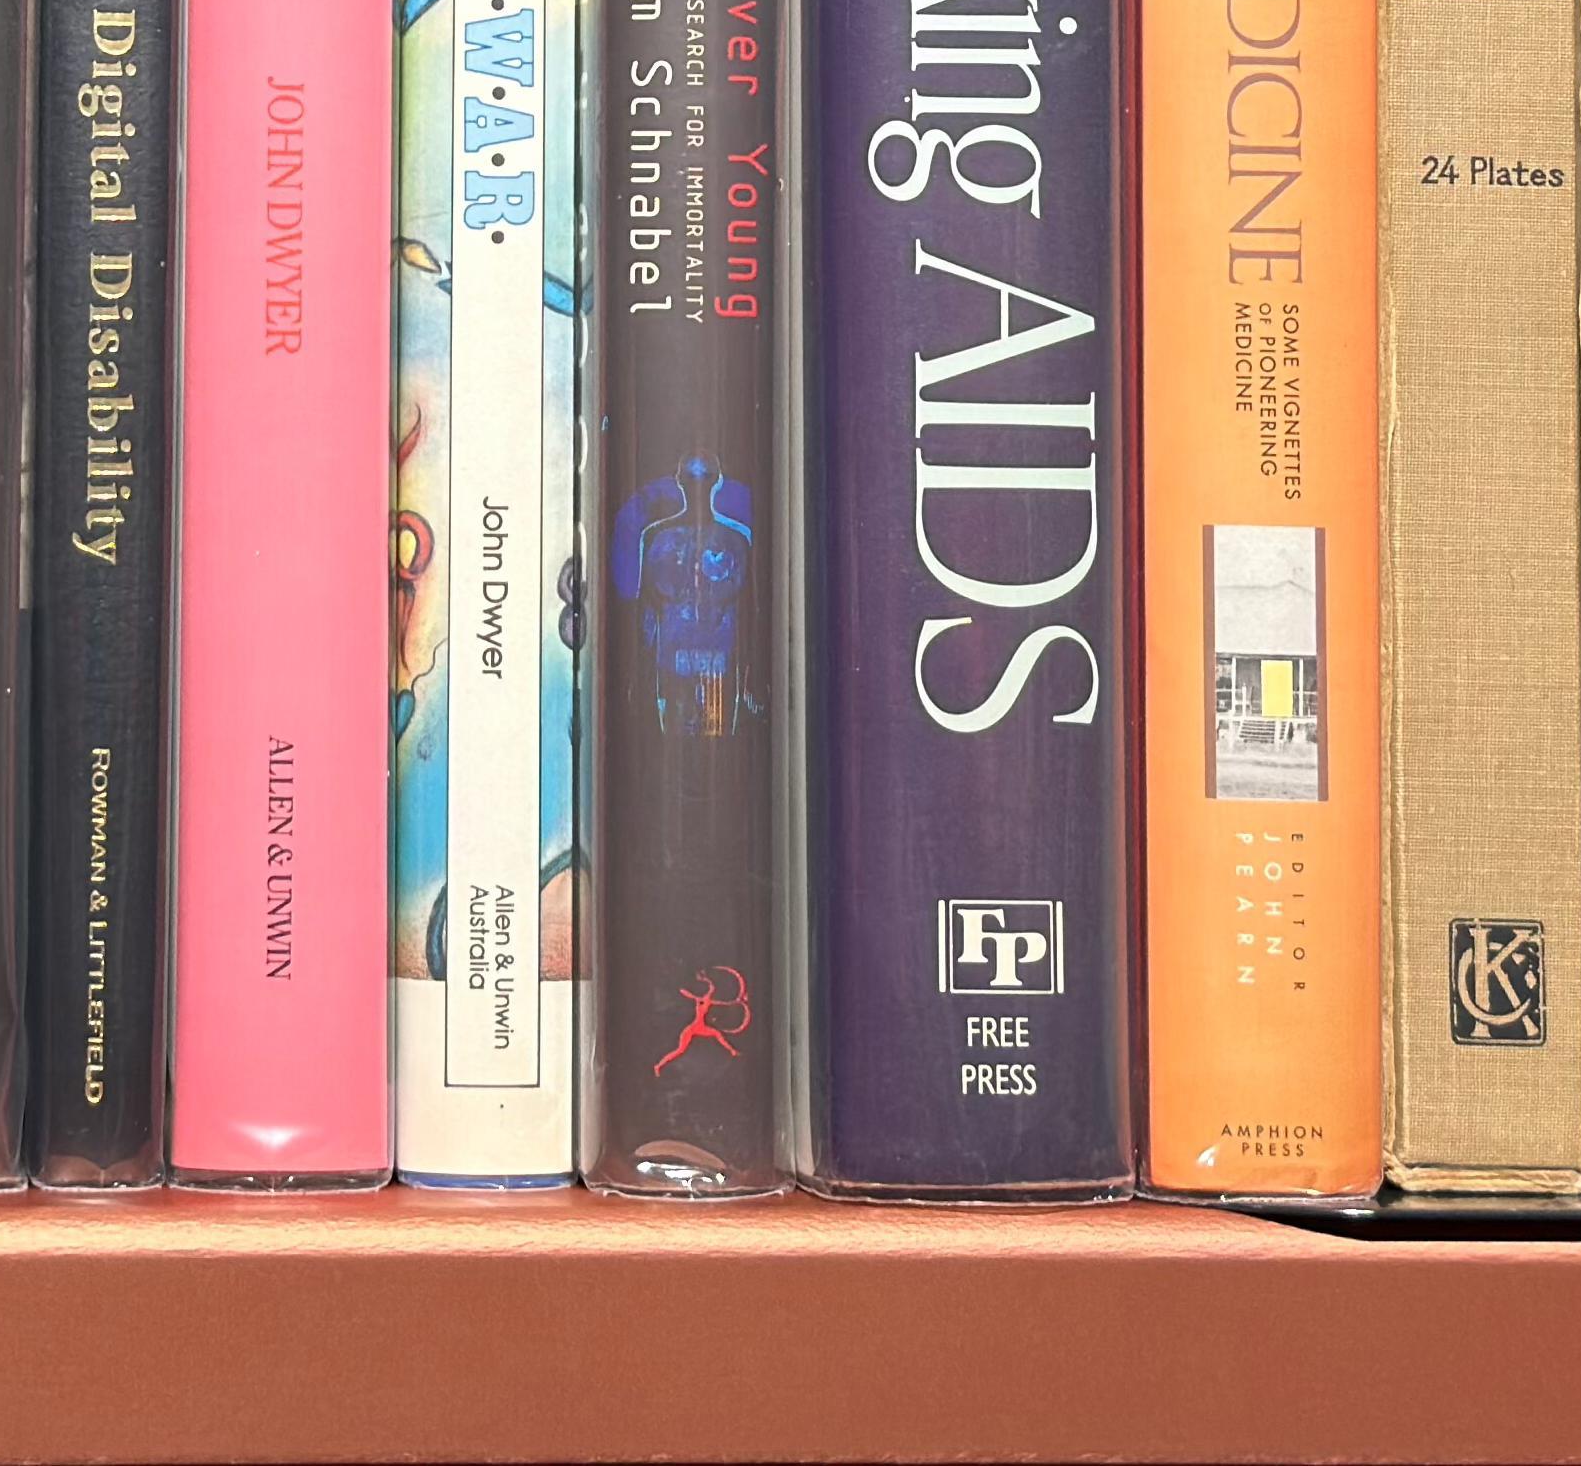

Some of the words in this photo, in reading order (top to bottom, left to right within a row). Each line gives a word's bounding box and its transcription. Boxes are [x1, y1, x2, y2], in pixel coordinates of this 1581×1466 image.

[686, 0, 704, 87] SEARCH
[78, 9, 137, 223] Digital
[266, 75, 304, 190] JOHN
[686, 106, 704, 148] FOR
[629, 60, 673, 314] Schnabel
[1421, 157, 1459, 185] 24
[1470, 158, 1565, 188] Plates
[265, 202, 304, 356] DWYER
[685, 167, 704, 324] IMMORTALITY
[715, 144, 769, 319] Young
[1235, 303, 1253, 413] MEDICINE
[1258, 302, 1272, 326] OF
[1283, 304, 1299, 367] SOME
[72, 252, 135, 566] Disability
[1260, 335, 1277, 477] PIONEERING
[1284, 379, 1301, 500] VIGNETTES
[482, 497, 509, 570] John
[914, 238, 1099, 732] AIDS
[481, 581, 509, 680] Dwyer
[89, 747, 112, 882] ROWMAN
[268, 735, 295, 836] ALLEN
[266, 876, 293, 980] UNWIN
[468, 885, 488, 991] Australia
[494, 885, 514, 948] Allen
[1236, 832, 1255, 984] PEARN
[1264, 832, 1283, 954] JOHN
[1292, 833, 1305, 990] EDITOR
[85, 921, 107, 1106] LITTLEFIELD
[494, 978, 512, 1050] Unwin
[967, 1016, 1029, 1048] FREE
[961, 1063, 1037, 1095] PRESS
[1221, 1123, 1323, 1140] AMPHION
[1242, 1142, 1304, 1157] PRESS
